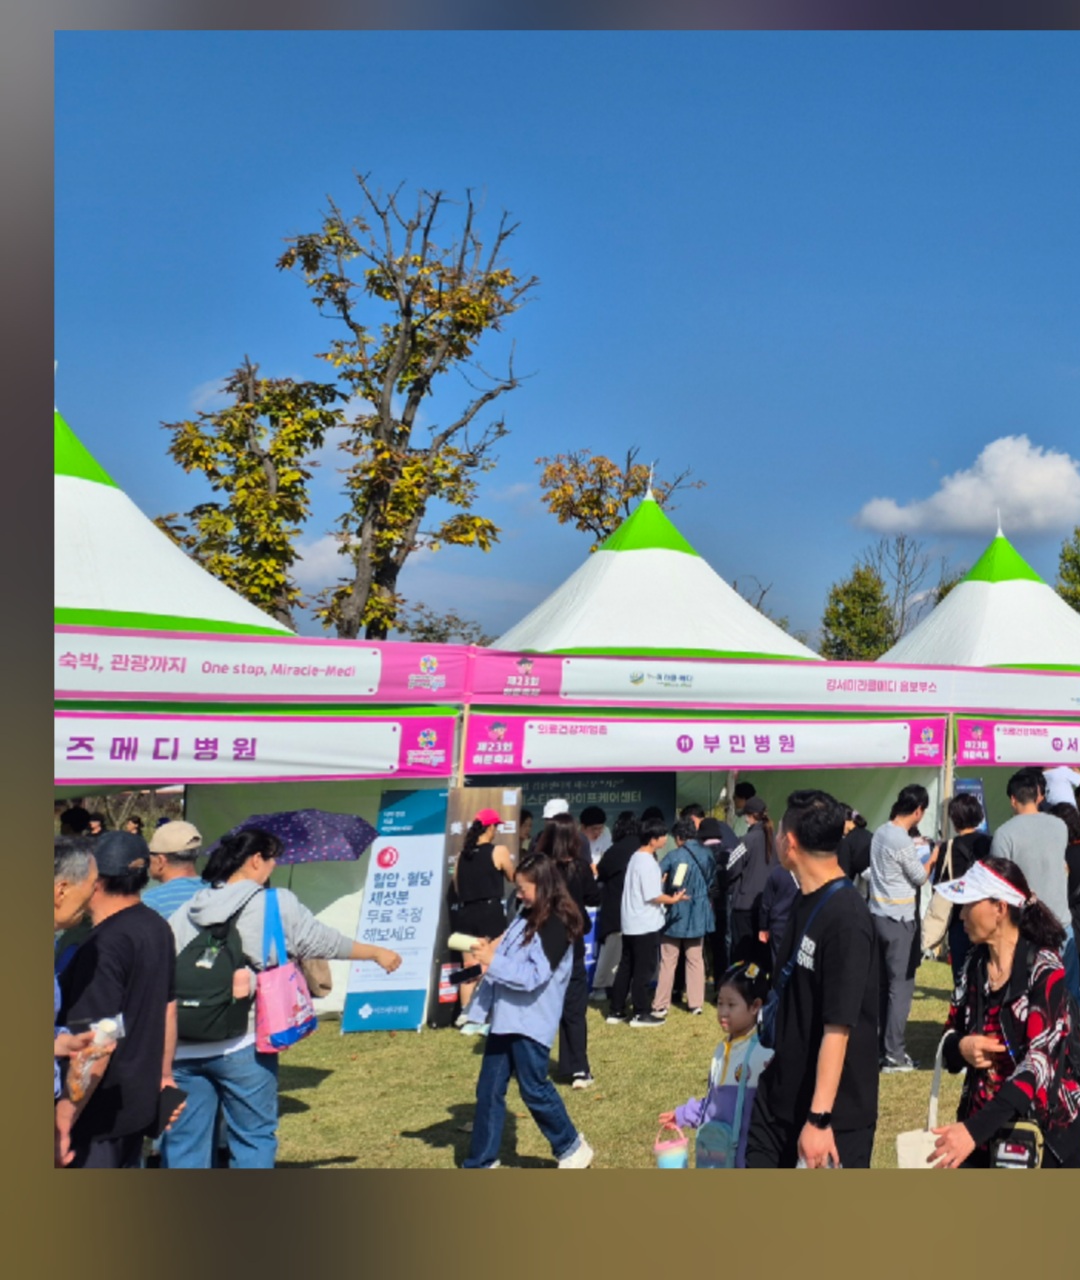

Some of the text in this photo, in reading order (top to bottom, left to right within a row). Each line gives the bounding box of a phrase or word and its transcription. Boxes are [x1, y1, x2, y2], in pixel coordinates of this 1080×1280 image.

[58, 650, 104, 674] 숙박,
[110, 653, 188, 675] 관광까지
[201, 659, 230, 676] One
[232, 660, 268, 677] stop,
[65, 736, 257, 762] 즈메디병원
[702, 734, 796, 754] 부민병원
[368, 890, 410, 906] 체성분
[366, 907, 424, 924] 무료 측정
[362, 925, 417, 943] 해보세요
